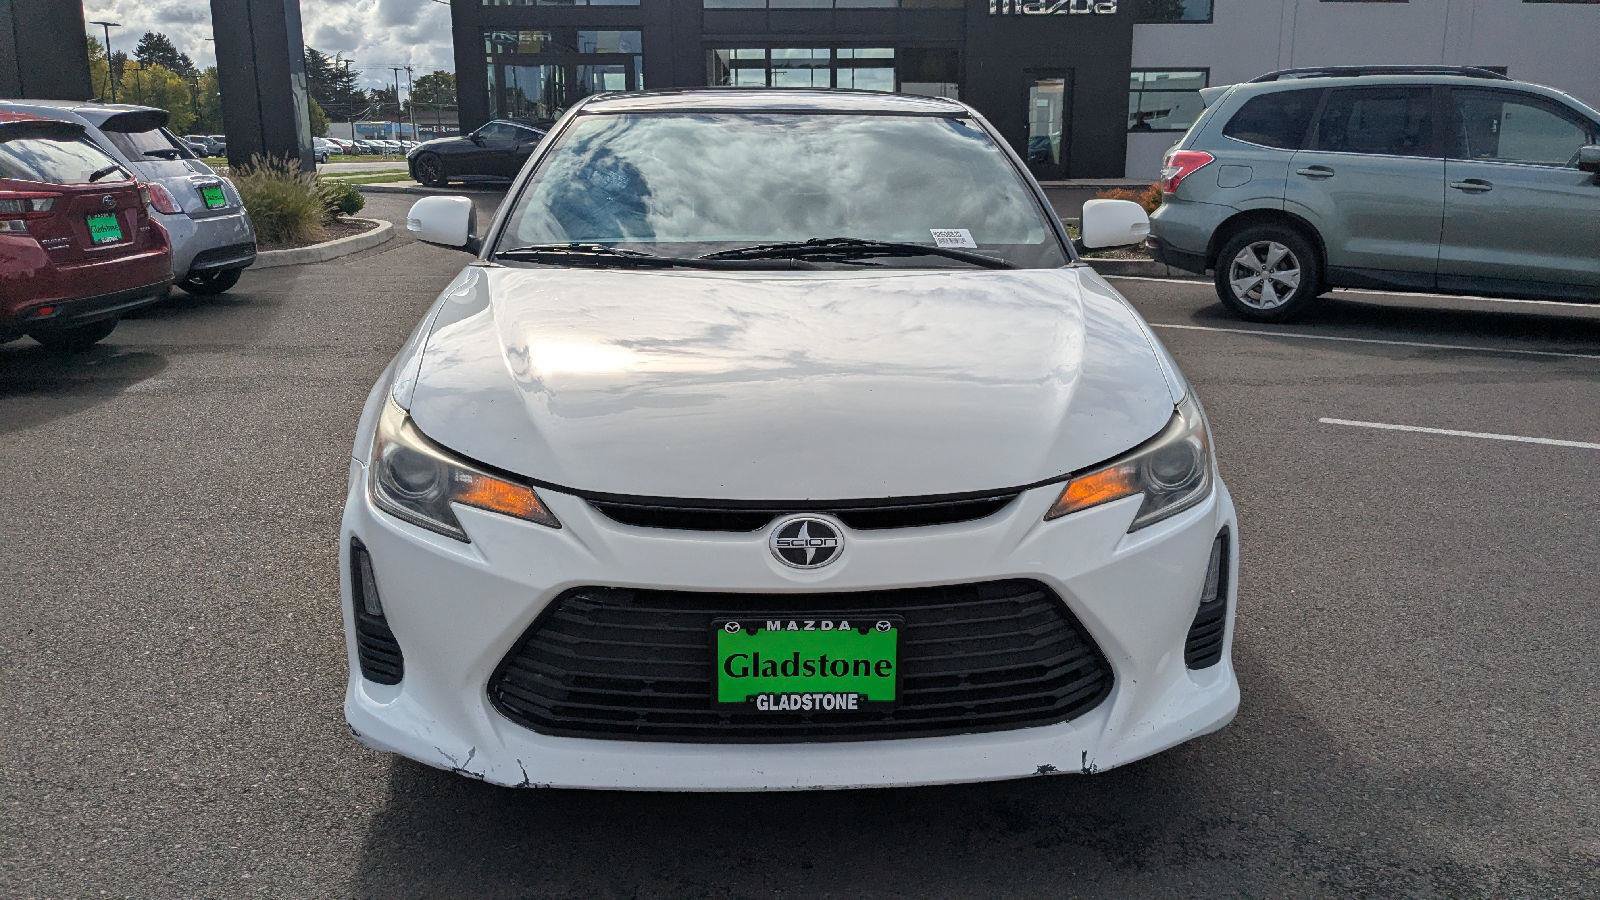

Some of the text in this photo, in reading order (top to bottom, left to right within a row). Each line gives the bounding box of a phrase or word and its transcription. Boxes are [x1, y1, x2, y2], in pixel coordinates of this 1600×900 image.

[776, 537, 838, 547] SCION
[766, 620, 851, 631] MAZDA
[723, 651, 893, 678] Gladstone
[756, 693, 858, 711] GLADSTONE
